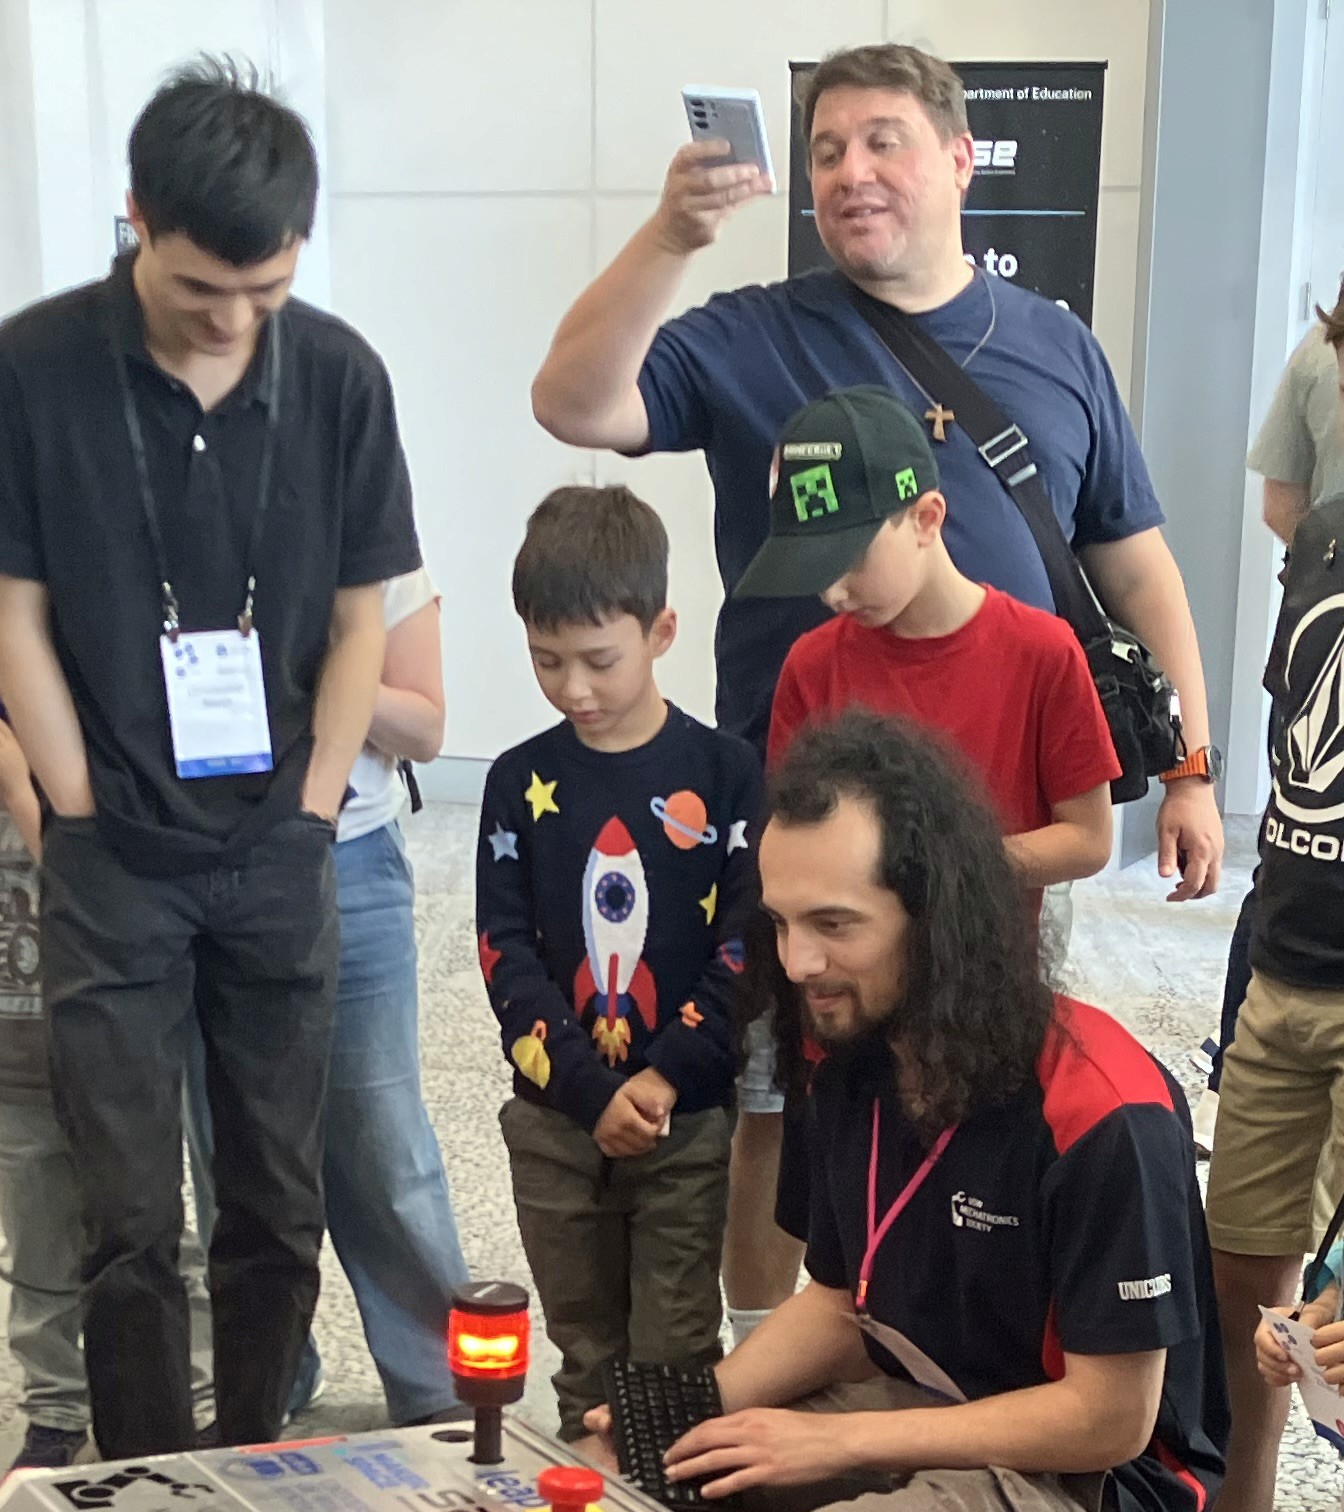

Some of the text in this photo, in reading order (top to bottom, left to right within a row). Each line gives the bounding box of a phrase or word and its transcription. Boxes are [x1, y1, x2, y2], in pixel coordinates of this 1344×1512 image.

[1016, 87, 1030, 100] of
[1032, 86, 1093, 101] Education
[983, 247, 1018, 278] to
